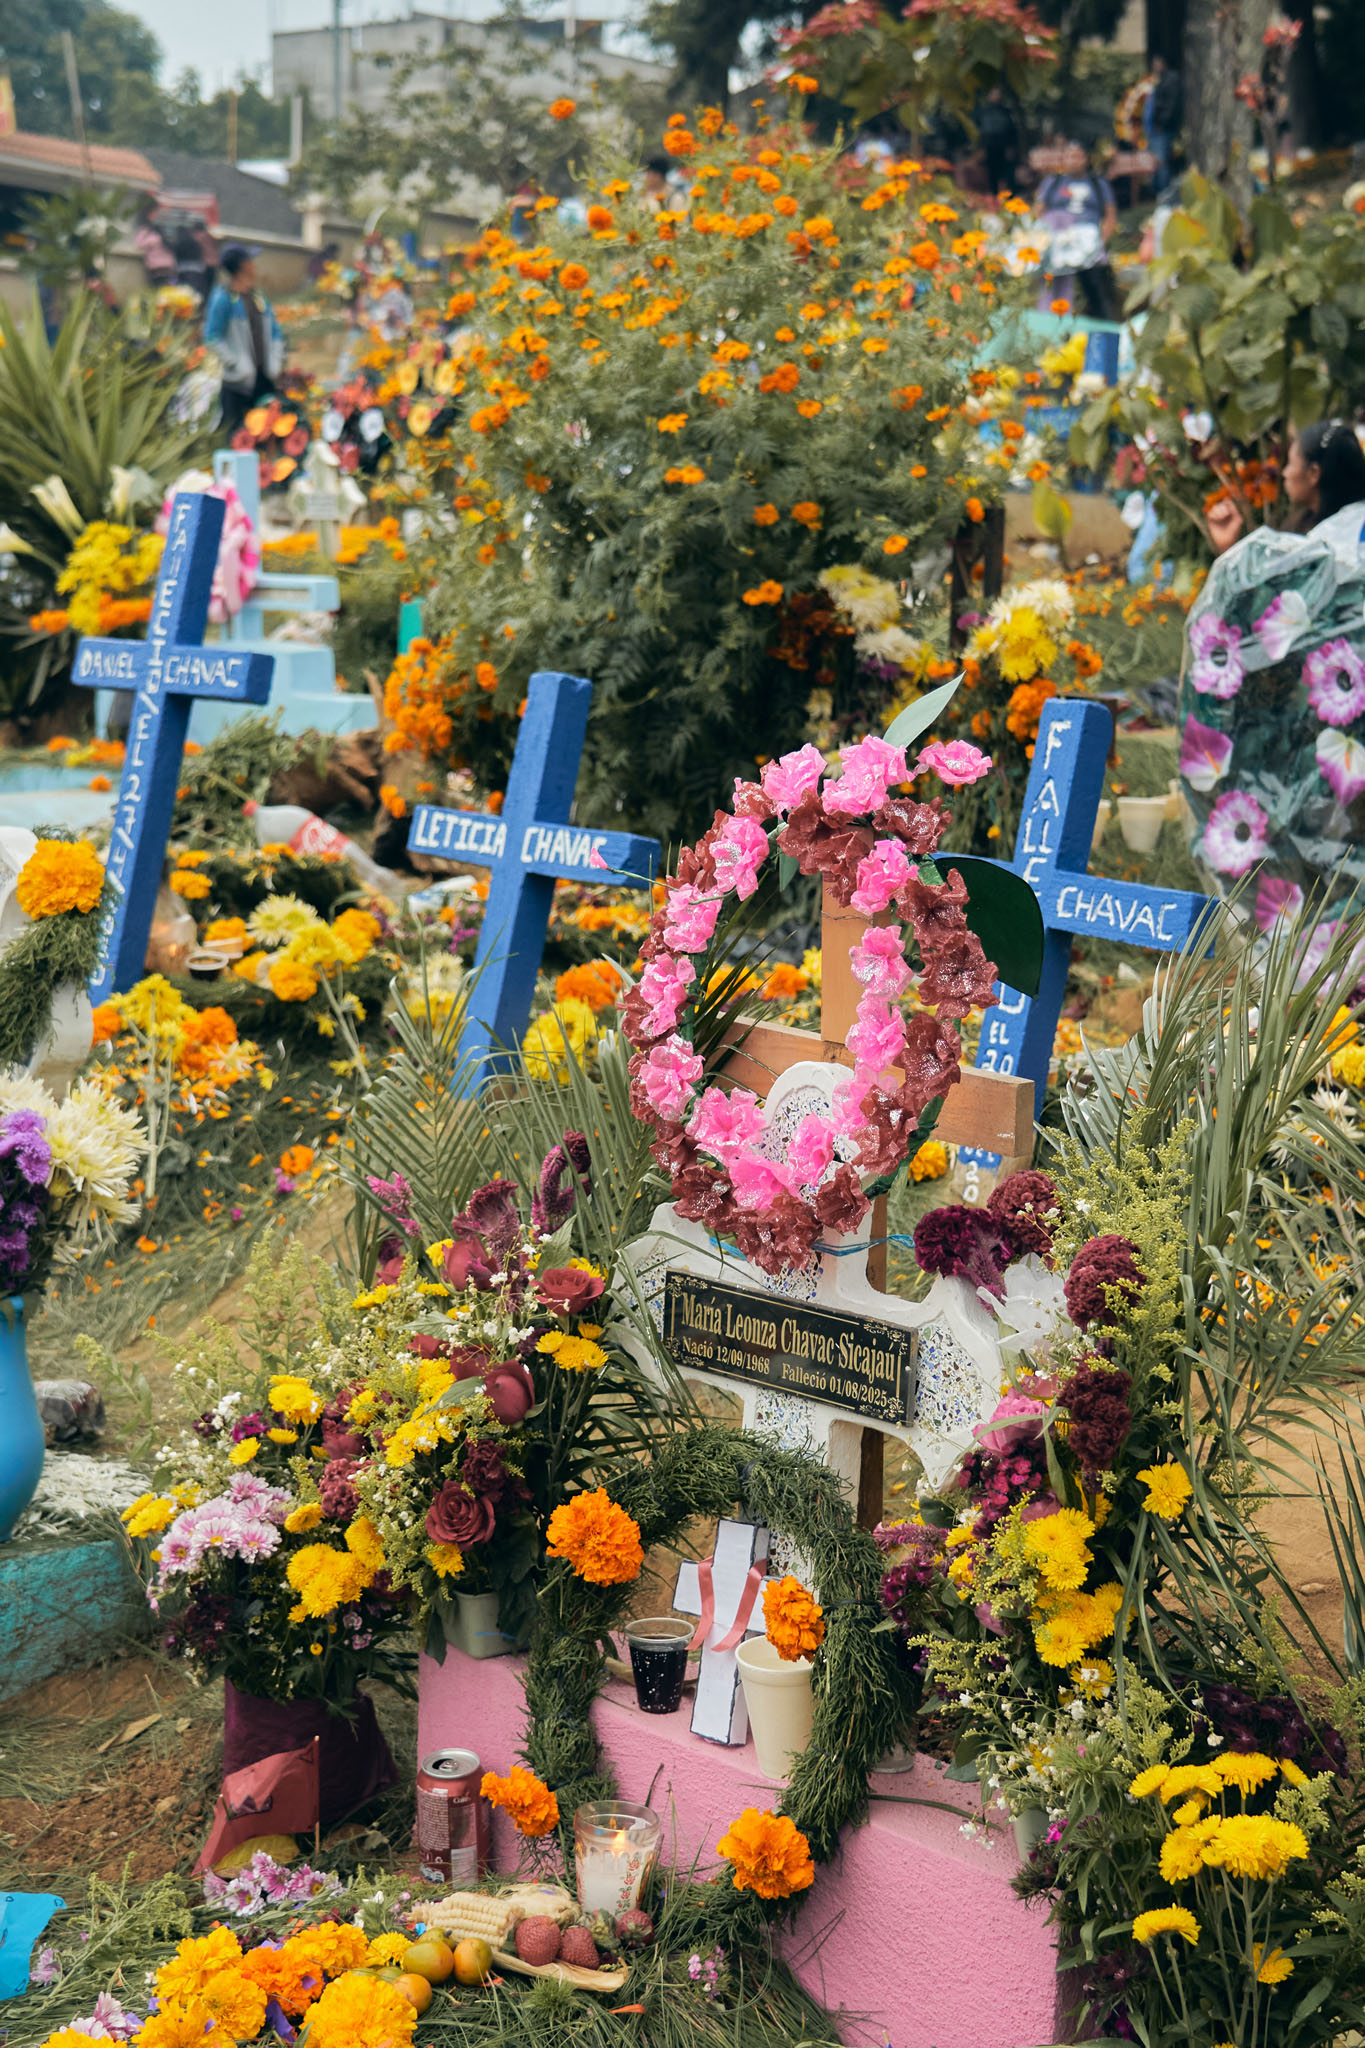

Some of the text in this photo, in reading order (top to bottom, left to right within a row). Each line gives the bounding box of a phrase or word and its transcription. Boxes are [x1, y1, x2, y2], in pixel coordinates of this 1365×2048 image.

[163, 655, 243, 689] CHAVAC
[413, 808, 508, 859] LETICIA
[1056, 885, 1178, 941] CHAVAC
[989, 1020, 1010, 1045] EL
[681, 1291, 895, 1384] María Leonza Chavac Sicajaú
[682, 1335, 888, 1407] Nació 12/09/1968 Falleció 01/08/2025
